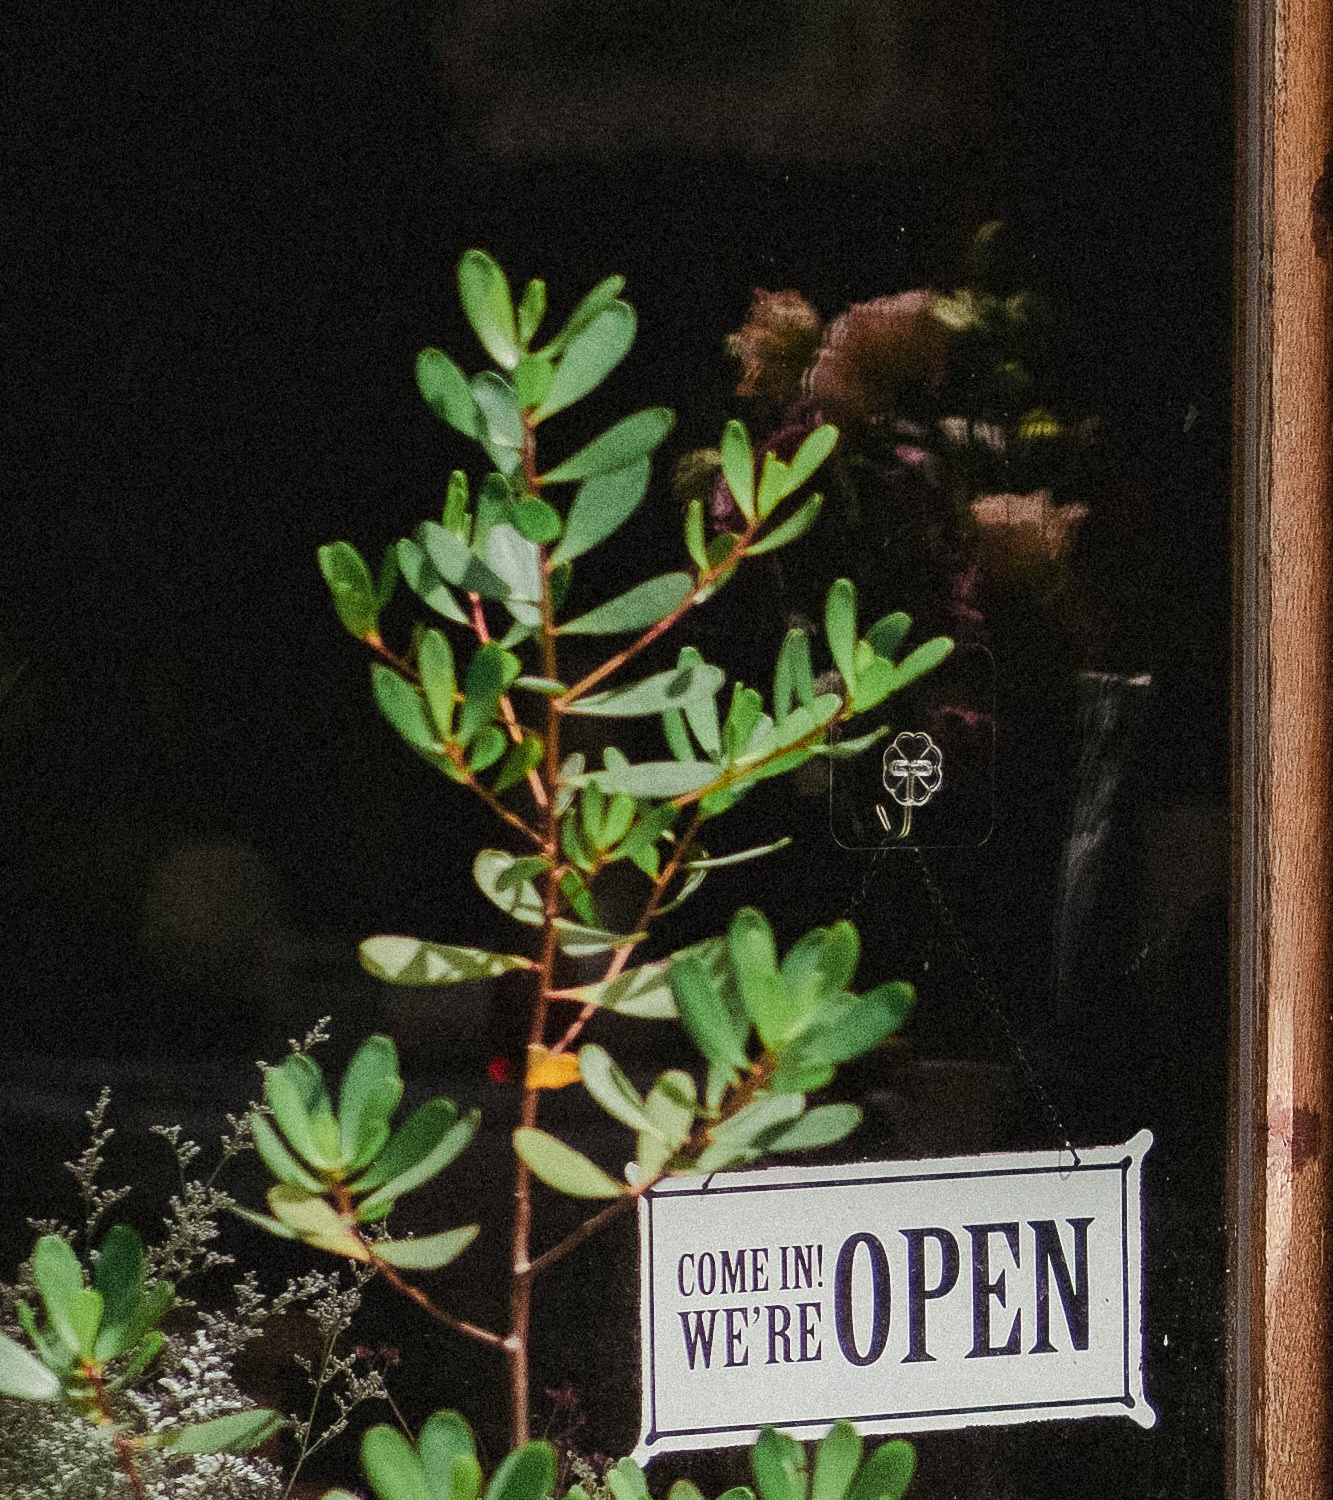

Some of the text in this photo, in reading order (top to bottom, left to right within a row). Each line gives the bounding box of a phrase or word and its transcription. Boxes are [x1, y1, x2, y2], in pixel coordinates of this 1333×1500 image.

[677, 1243, 824, 1298] COME IN!
[833, 1216, 1096, 1367] OPEN
[677, 1302, 823, 1371] WE'RE
